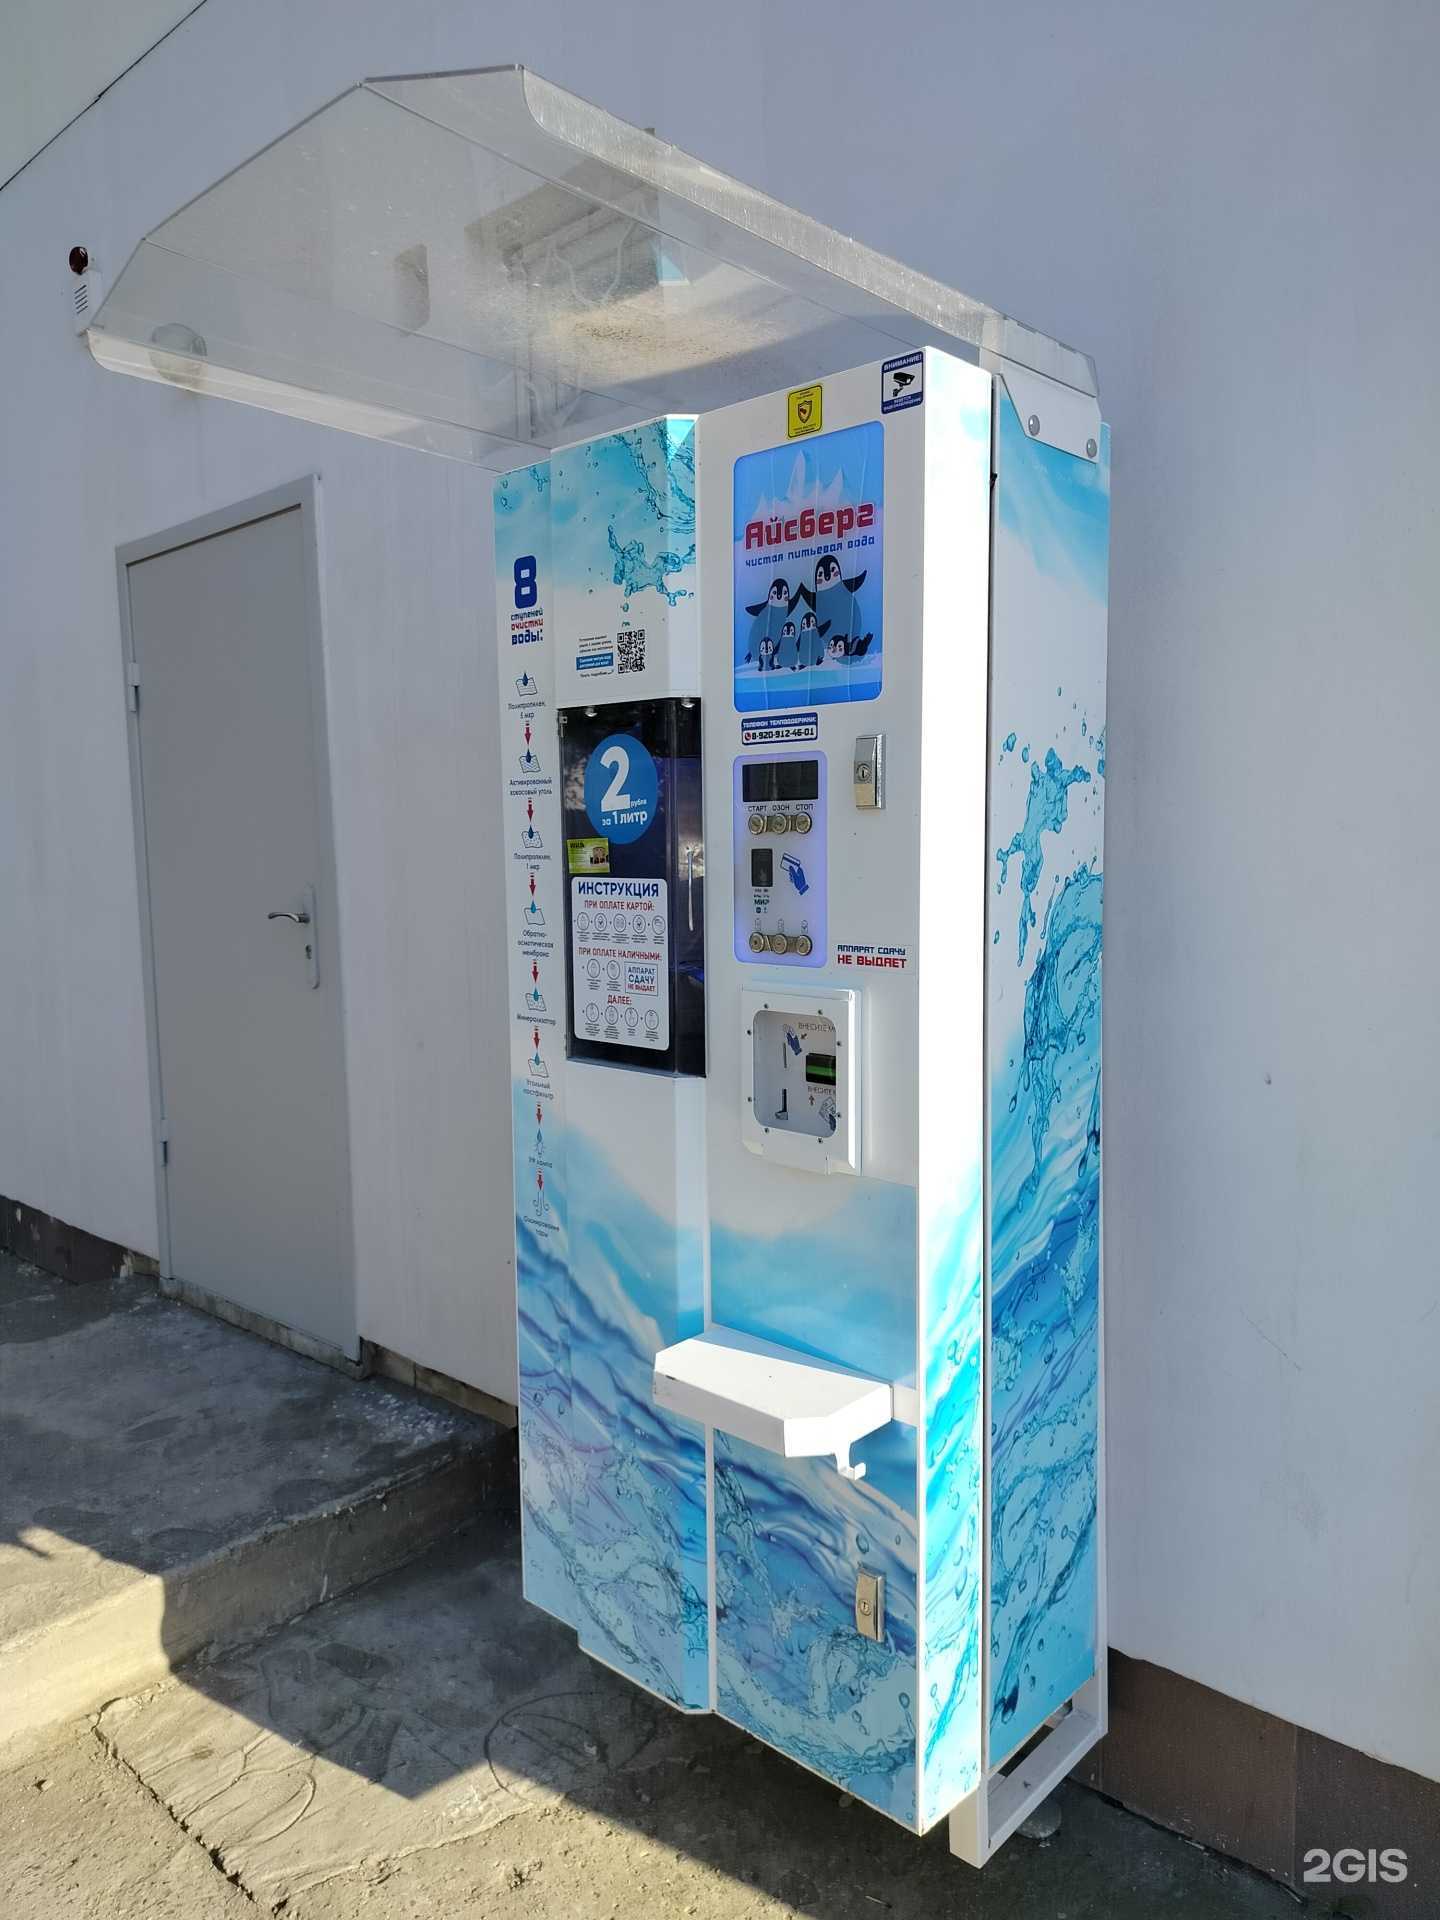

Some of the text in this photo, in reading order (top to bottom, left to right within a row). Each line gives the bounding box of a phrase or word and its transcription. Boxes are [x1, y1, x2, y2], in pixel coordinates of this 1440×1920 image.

[883, 354, 922, 371] ВНИМАНИЕ!
[745, 503, 875, 550] Айсберг
[745, 536, 875, 567] чистая питьевая вода
[514, 555, 537, 609] 8
[511, 608, 544, 621] ступеней
[511, 619, 544, 631] очистки
[511, 629, 543, 645] воды:
[600, 745, 630, 812] 2
[630, 799, 647, 808] рубля
[795, 803, 814, 811] СТОП
[612, 811, 618, 825] 1
[619, 810, 648, 825] литр
[578, 881, 659, 899] ИНСТРУКЦИЯ
[584, 900, 655, 911] ПРИ ОПЛАТЕ КАРТОЙ:
[578, 947, 591, 955] ПРИ
[592, 948, 617, 957] ОПЛАТЕ
[837, 944, 906, 956] АППАРАТ СДАЧУ
[837, 954, 907, 968] НЕ ВЫДАЕТ
[628, 966, 656, 975] АППАРАТ
[628, 974, 655, 984] СДАЧУ
[607, 995, 632, 1005] ДАЛЕЕ:
